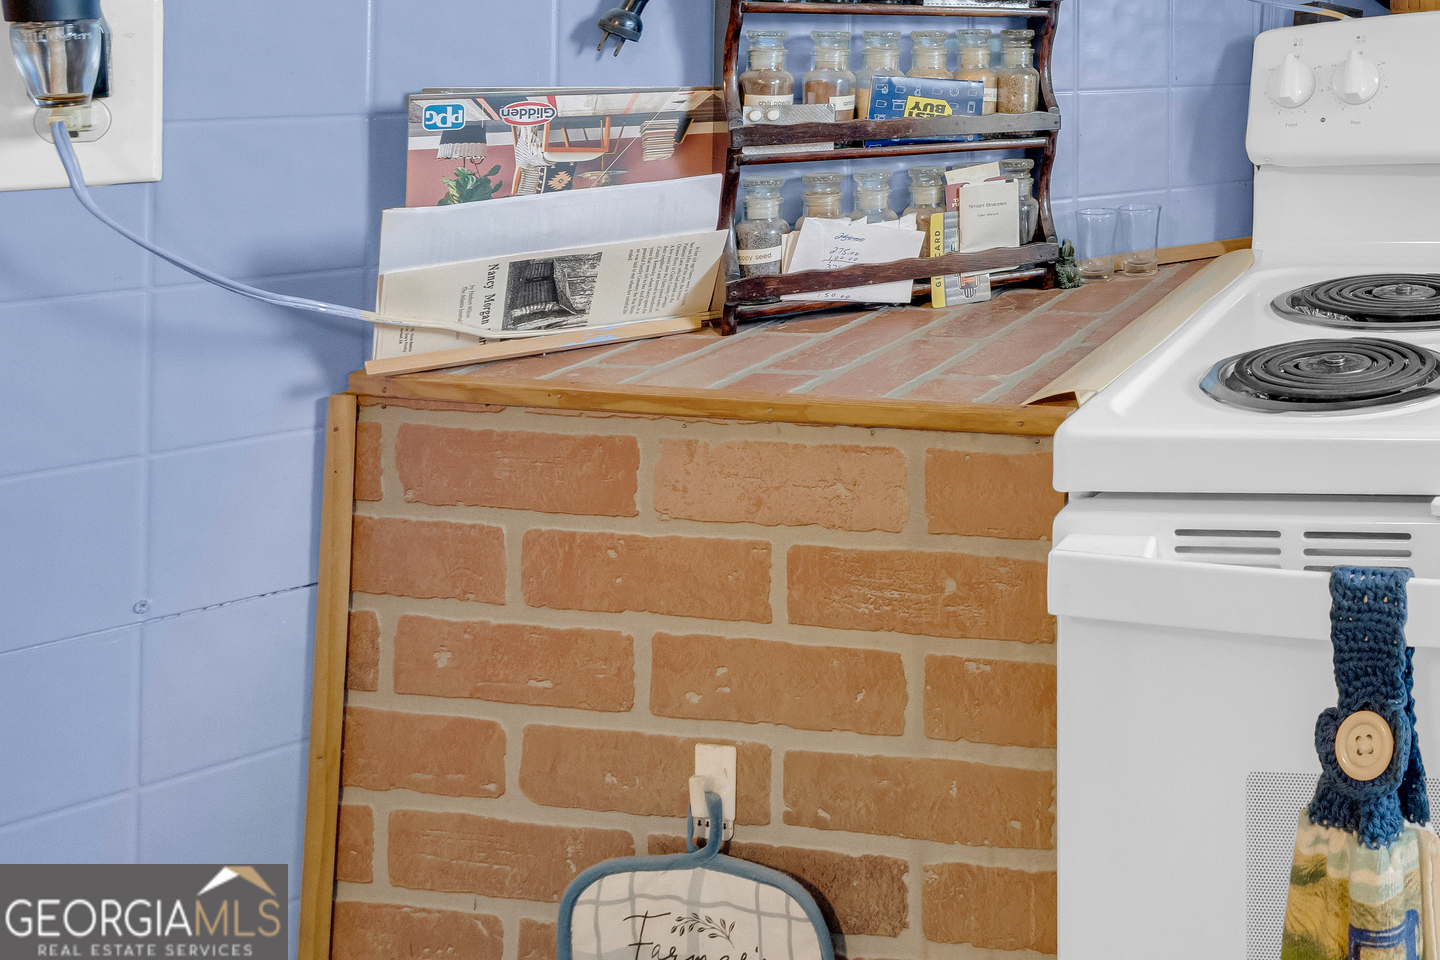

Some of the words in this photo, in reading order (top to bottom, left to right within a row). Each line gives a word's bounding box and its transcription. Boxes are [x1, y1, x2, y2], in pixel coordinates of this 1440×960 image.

[501, 108, 555, 120] Glidden
[910, 101, 946, 113] BUY
[484, 264, 499, 289] Nancy
[480, 293, 496, 325] Morgan
